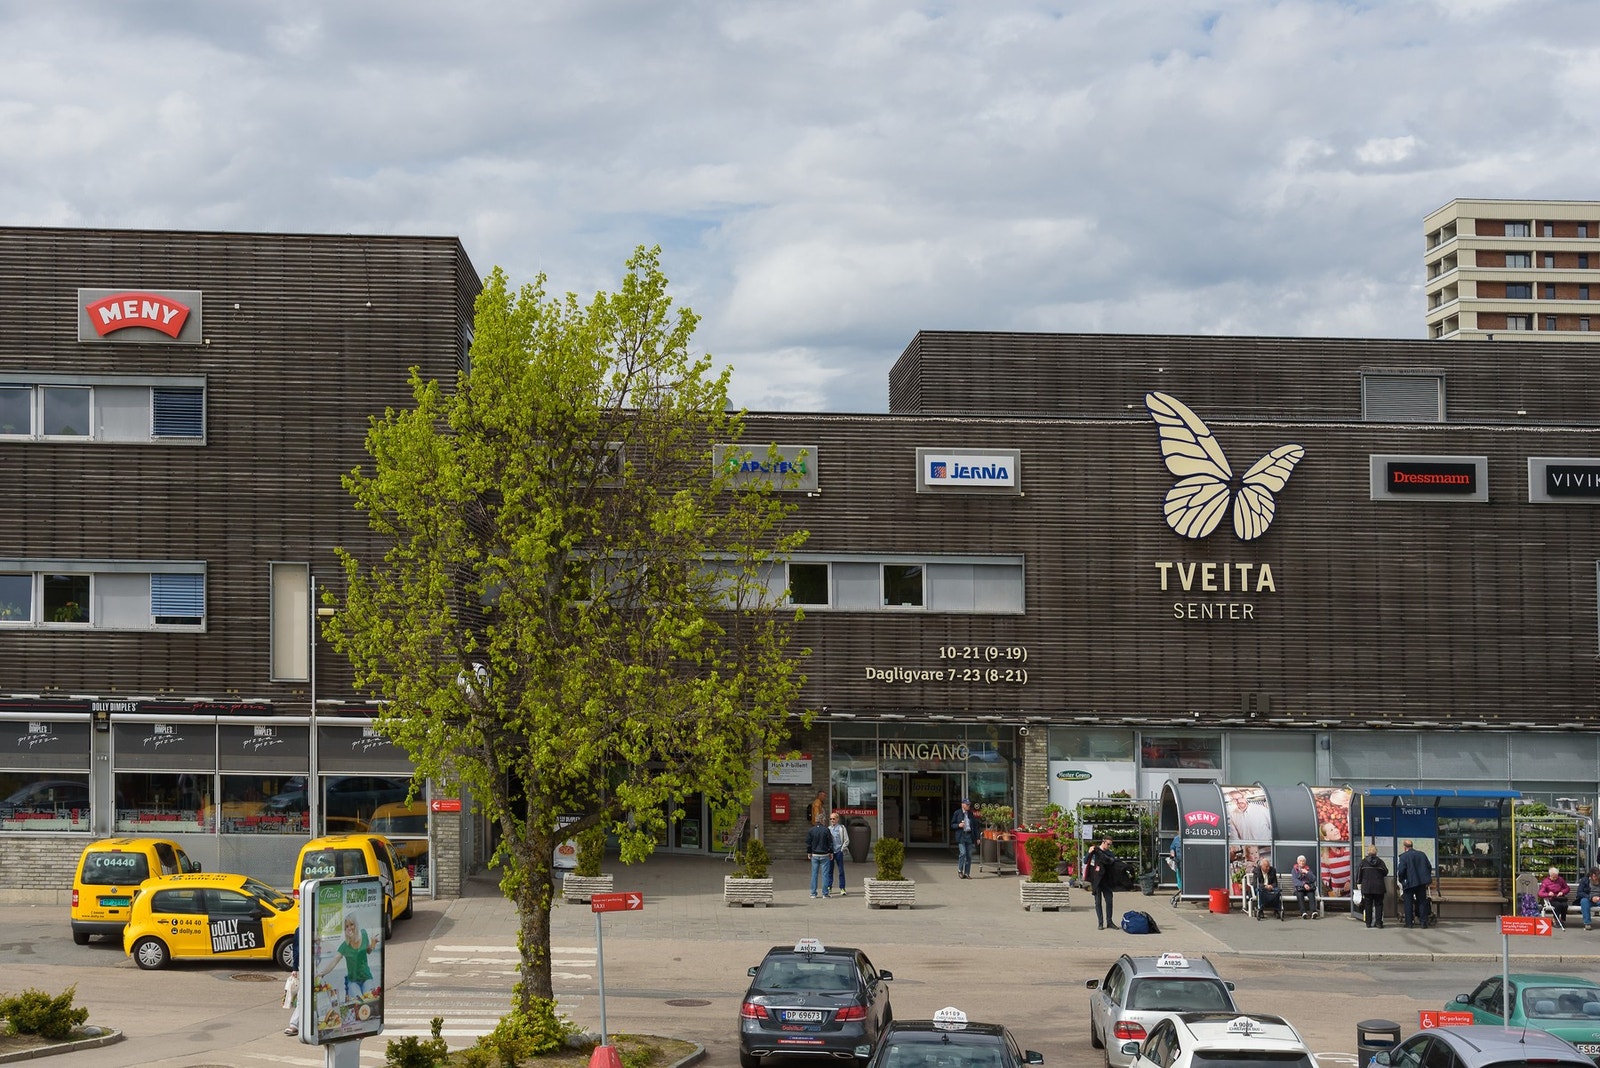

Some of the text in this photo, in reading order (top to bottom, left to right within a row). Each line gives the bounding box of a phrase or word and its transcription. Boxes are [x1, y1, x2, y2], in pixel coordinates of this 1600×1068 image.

[98, 300, 179, 325] MENY
[1393, 471, 1470, 484] Dressmann
[1155, 562, 1276, 592] TVEITA
[1173, 602, 1254, 620] SENTER
[939, 646, 1028, 662] 10-21 (9-19)
[865, 667, 1028, 684] Dagligvare 7-23 (8-21)
[92, 702, 110, 711] DOLLY
[883, 743, 969, 760] INNGANG
[1188, 813, 1216, 822] MENY
[1185, 828, 1221, 836] 8-21(9-19)
[103, 858, 135, 867] 04440
[305, 865, 336, 875] 04440
[179, 927, 202, 935] dolly.no
[211, 919, 239, 937] DOLLY
[213, 931, 256, 952] DIMPLE'S
[786, 1011, 820, 1020] DP 69673
